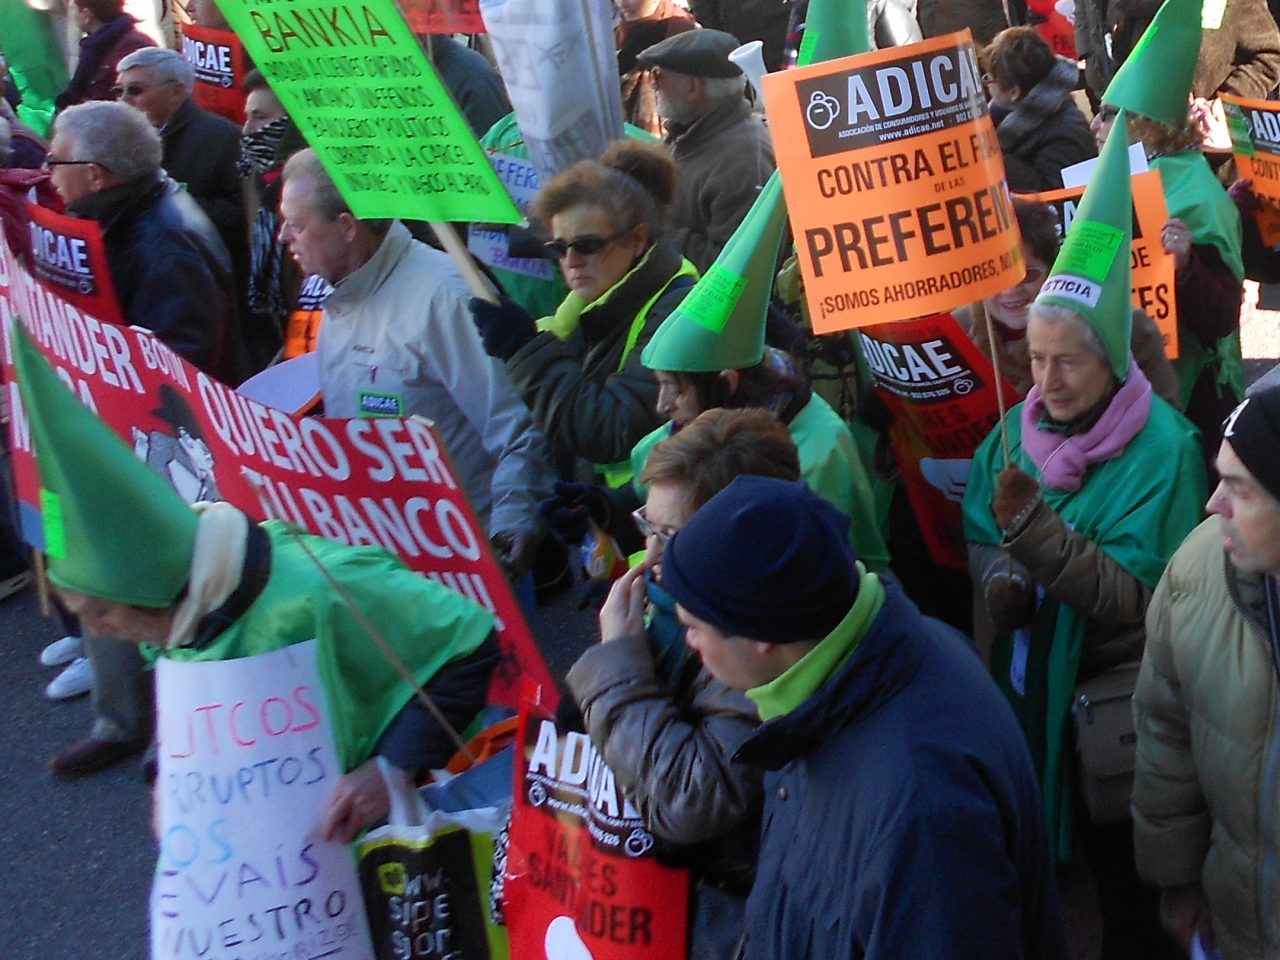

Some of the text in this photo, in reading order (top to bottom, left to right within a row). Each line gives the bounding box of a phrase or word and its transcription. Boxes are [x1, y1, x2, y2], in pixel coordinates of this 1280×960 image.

[249, 4, 397, 54] BANKIA
[879, 119, 945, 142] www.adicae.net
[817, 140, 969, 200] CONTRA EL
[934, 175, 966, 193] DE LAS
[819, 288, 881, 320] ¡SOMOS
[883, 261, 1001, 306] AHORRADORES,
[197, 371, 351, 481] QUIERO
[345, 417, 457, 490] SER
[298, 486, 481, 561] BANCO
